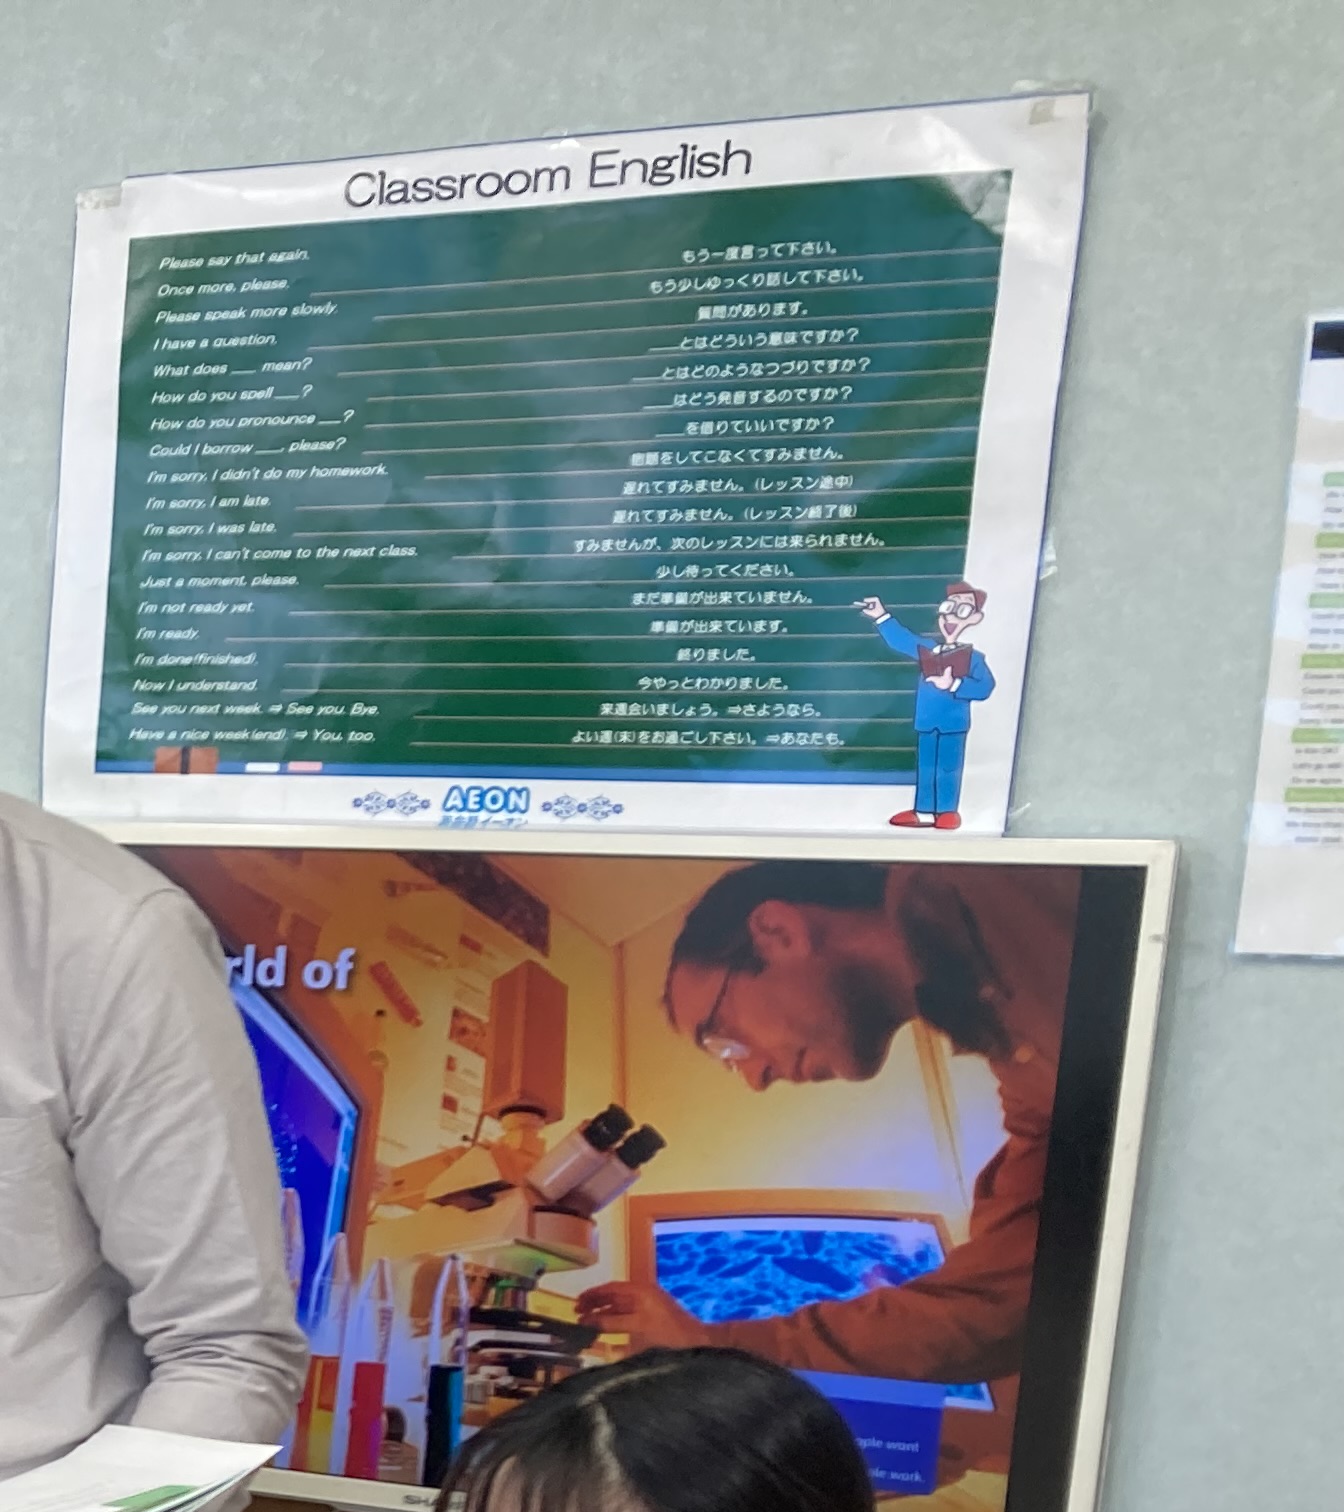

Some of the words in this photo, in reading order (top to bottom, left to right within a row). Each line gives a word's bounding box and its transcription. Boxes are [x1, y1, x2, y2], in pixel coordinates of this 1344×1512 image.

[345, 164, 572, 208] Classroom
[589, 140, 752, 188] English
[159, 256, 205, 270] Please
[207, 255, 233, 267] say
[234, 251, 266, 265] that
[267, 248, 308, 263] again.
[157, 283, 195, 297] Once
[239, 277, 289, 293] please.
[154, 310, 201, 324] Please
[203, 306, 248, 322] speak
[249, 306, 288, 319] more
[152, 337, 160, 351] I
[161, 337, 197, 351] have
[212, 333, 278, 348] question.
[153, 364, 191, 377] What
[192, 362, 228, 376] does
[261, 356, 313, 372] mean?
[151, 391, 186, 404] How
[187, 389, 208, 403] do
[209, 391, 238, 403] you
[239, 386, 275, 400] spell
[150, 417, 184, 431] How
[186, 416, 206, 430] do
[208, 417, 236, 430] you
[236, 414, 317, 428] pronounce
[149, 443, 193, 458] Could
[193, 442, 201, 456] I
[201, 442, 254, 456] borrow
[287, 436, 347, 453] please?
[146, 470, 168, 483] I'm
[211, 468, 219, 482] I
[219, 466, 261, 481] didn't
[262, 466, 283, 480] do
[285, 468, 308, 479] my
[309, 462, 389, 478] homework.
[145, 496, 166, 510] I'm
[209, 495, 217, 508] I
[218, 497, 240, 508] am
[242, 494, 270, 507] late.
[143, 522, 164, 536] I'm
[207, 521, 216, 534] I
[216, 523, 246, 534] was
[248, 520, 277, 534] late.
[141, 549, 162, 562] I'm
[206, 548, 213, 560] I
[214, 546, 251, 561] can't
[252, 549, 293, 560] come
[295, 547, 312, 559] to
[315, 545, 340, 559] the
[342, 546, 377, 558] next
[378, 543, 418, 558] class.
[656, 563, 794, 580] 少し待ってください。
[139, 576, 173, 589] Just
[250, 573, 299, 587] please.
[137, 600, 158, 615] I'm
[160, 602, 187, 614] not
[188, 600, 230, 614] ready
[230, 601, 254, 614] yet.
[135, 626, 157, 640] I'm
[158, 627, 199, 640] ready.
[133, 652, 155, 667] I'm
[676, 647, 756, 664] 終りました。
[132, 678, 167, 692] Now
[167, 678, 176, 691] I
[175, 678, 258, 692] understand.
[636, 676, 789, 693] 今やっとわかりました。
[131, 702, 159, 714] See
[160, 705, 188, 715] you
[189, 703, 221, 714] next
[285, 702, 315, 715] See
[316, 705, 346, 716] you.
[349, 702, 380, 716] Bye.
[128, 727, 165, 740] Have
[180, 728, 211, 741] nice
[347, 730, 376, 742] too.
[442, 785, 530, 813] AEON
[226, 943, 287, 987] rld
[302, 947, 356, 990] of
